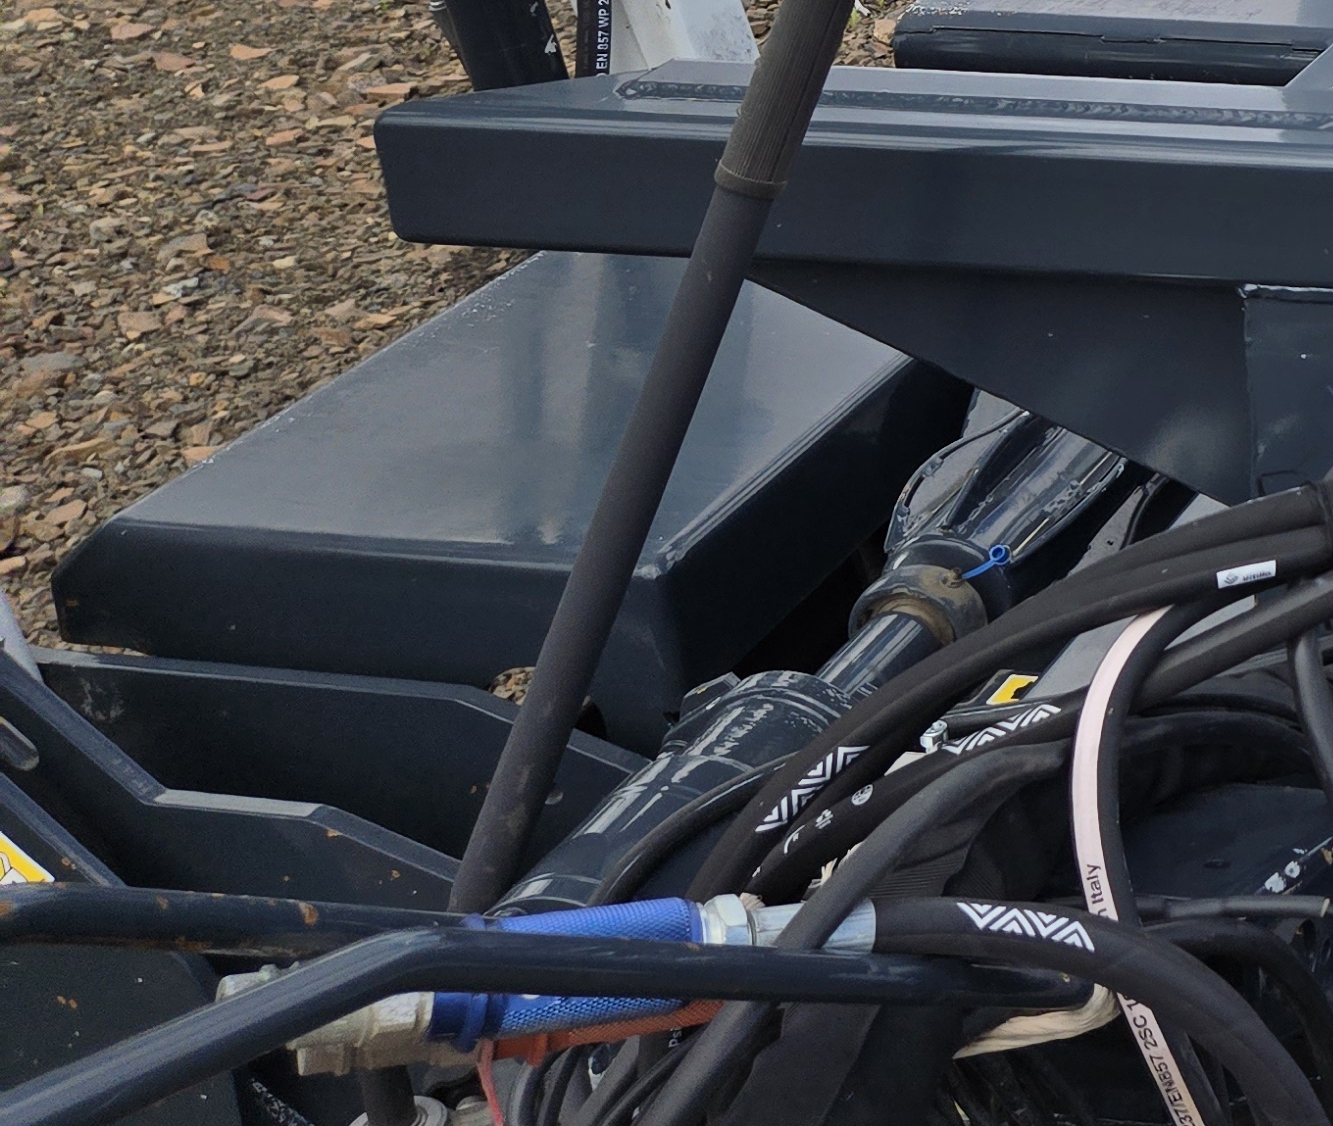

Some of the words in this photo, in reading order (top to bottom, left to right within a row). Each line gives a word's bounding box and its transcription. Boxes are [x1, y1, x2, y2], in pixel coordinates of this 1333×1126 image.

[598, 10, 610, 31] WP
[595, 54, 608, 70] EN
[1086, 864, 1104, 905] Italy
[1133, 1015, 1158, 1050] 2SC
